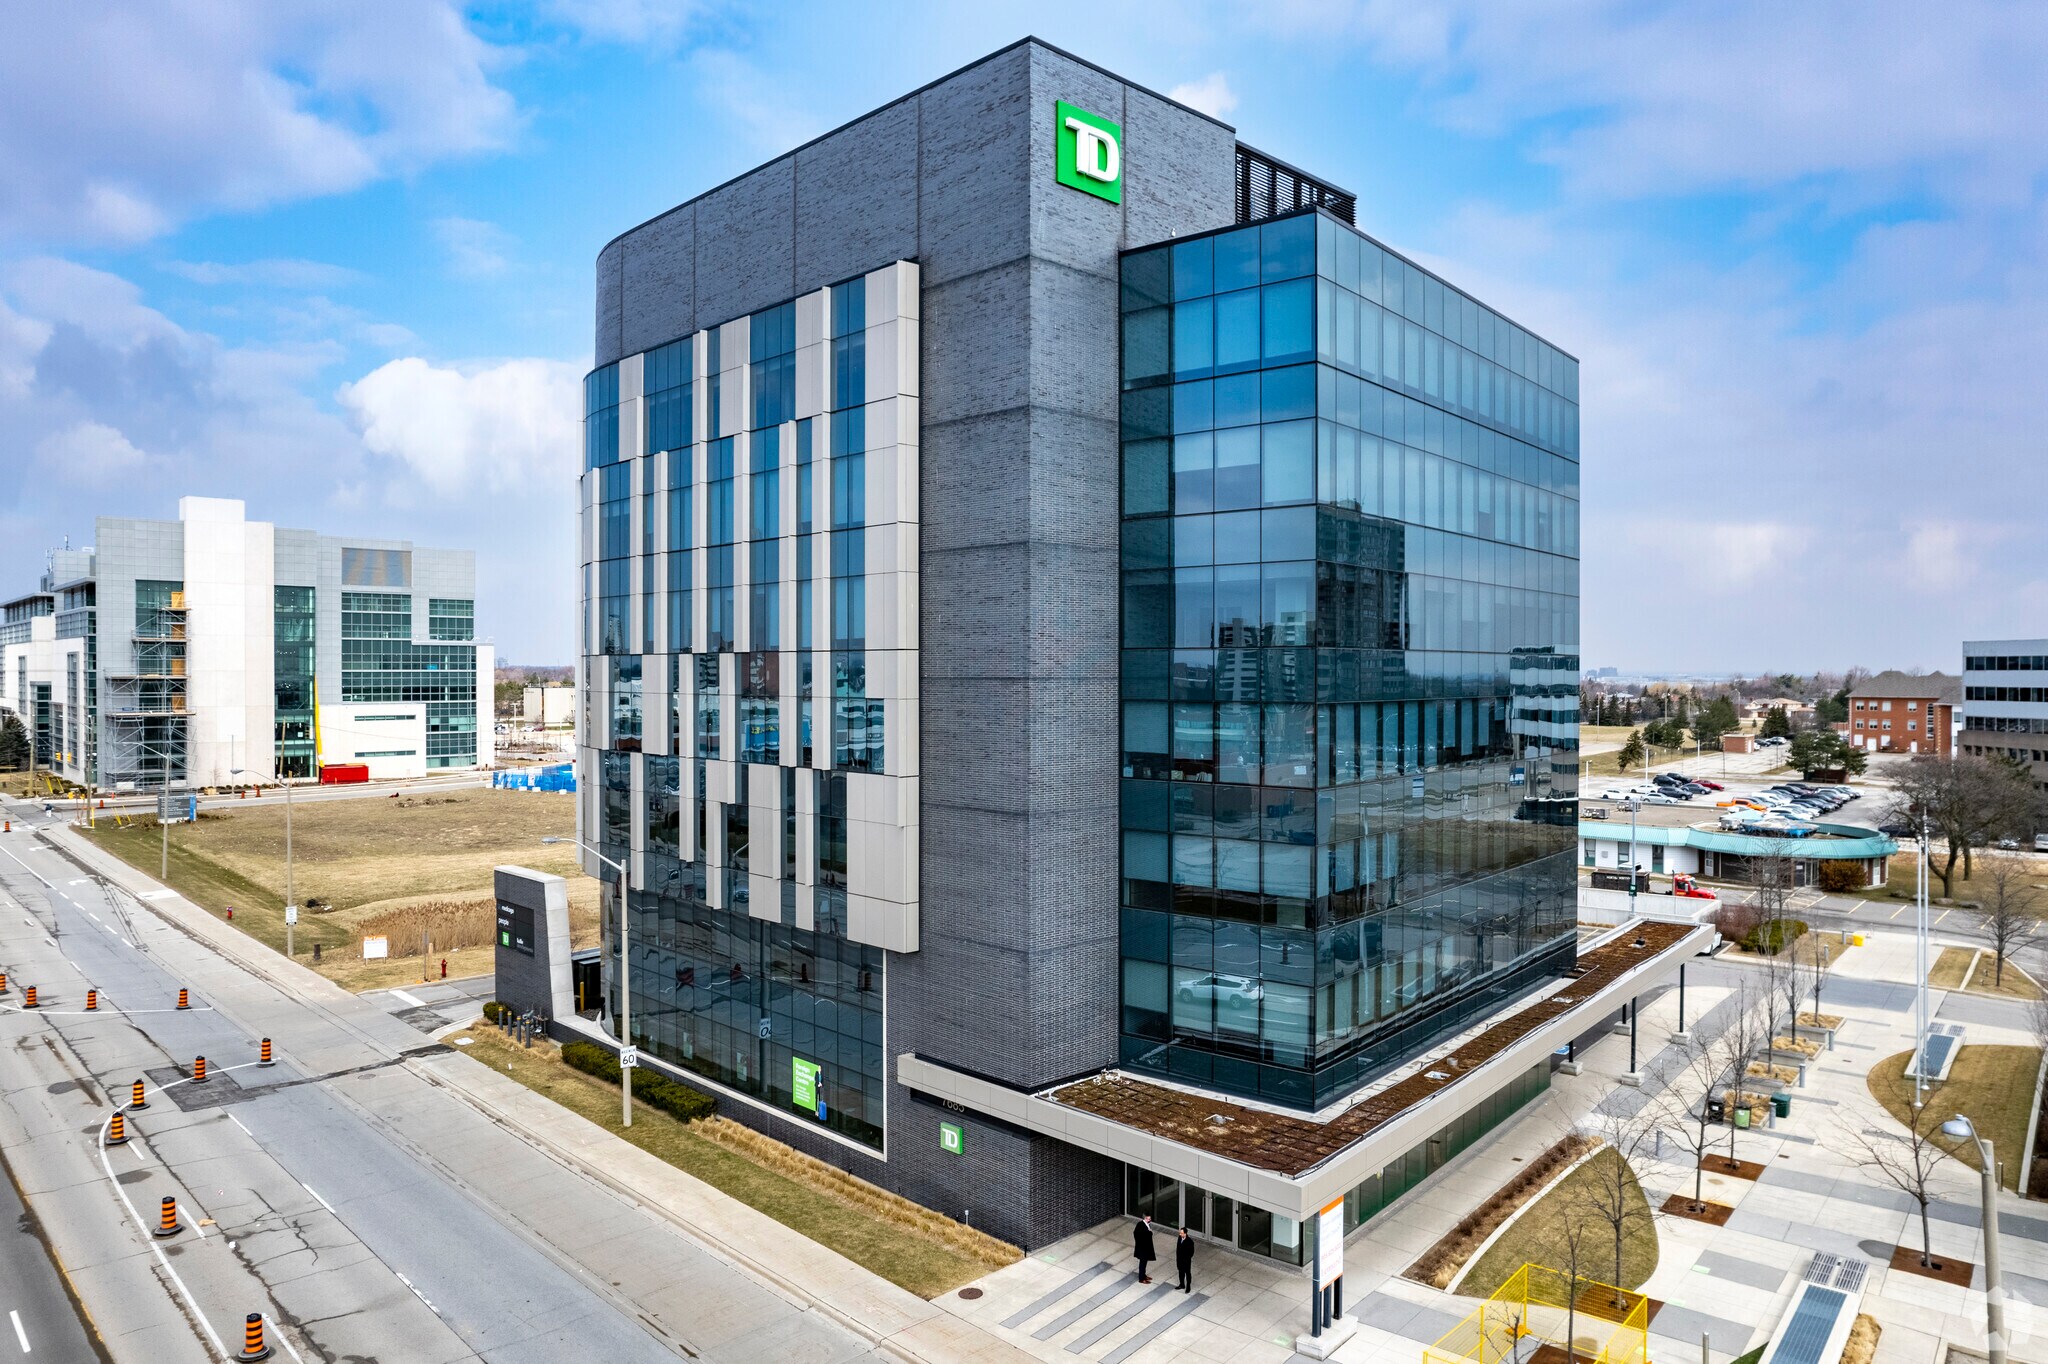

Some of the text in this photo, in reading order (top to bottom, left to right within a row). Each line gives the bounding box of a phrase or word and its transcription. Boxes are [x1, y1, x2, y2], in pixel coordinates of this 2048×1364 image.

[1065, 116, 1120, 182] TD
[622, 1054, 635, 1065] 60
[942, 1127, 958, 1148] TD
